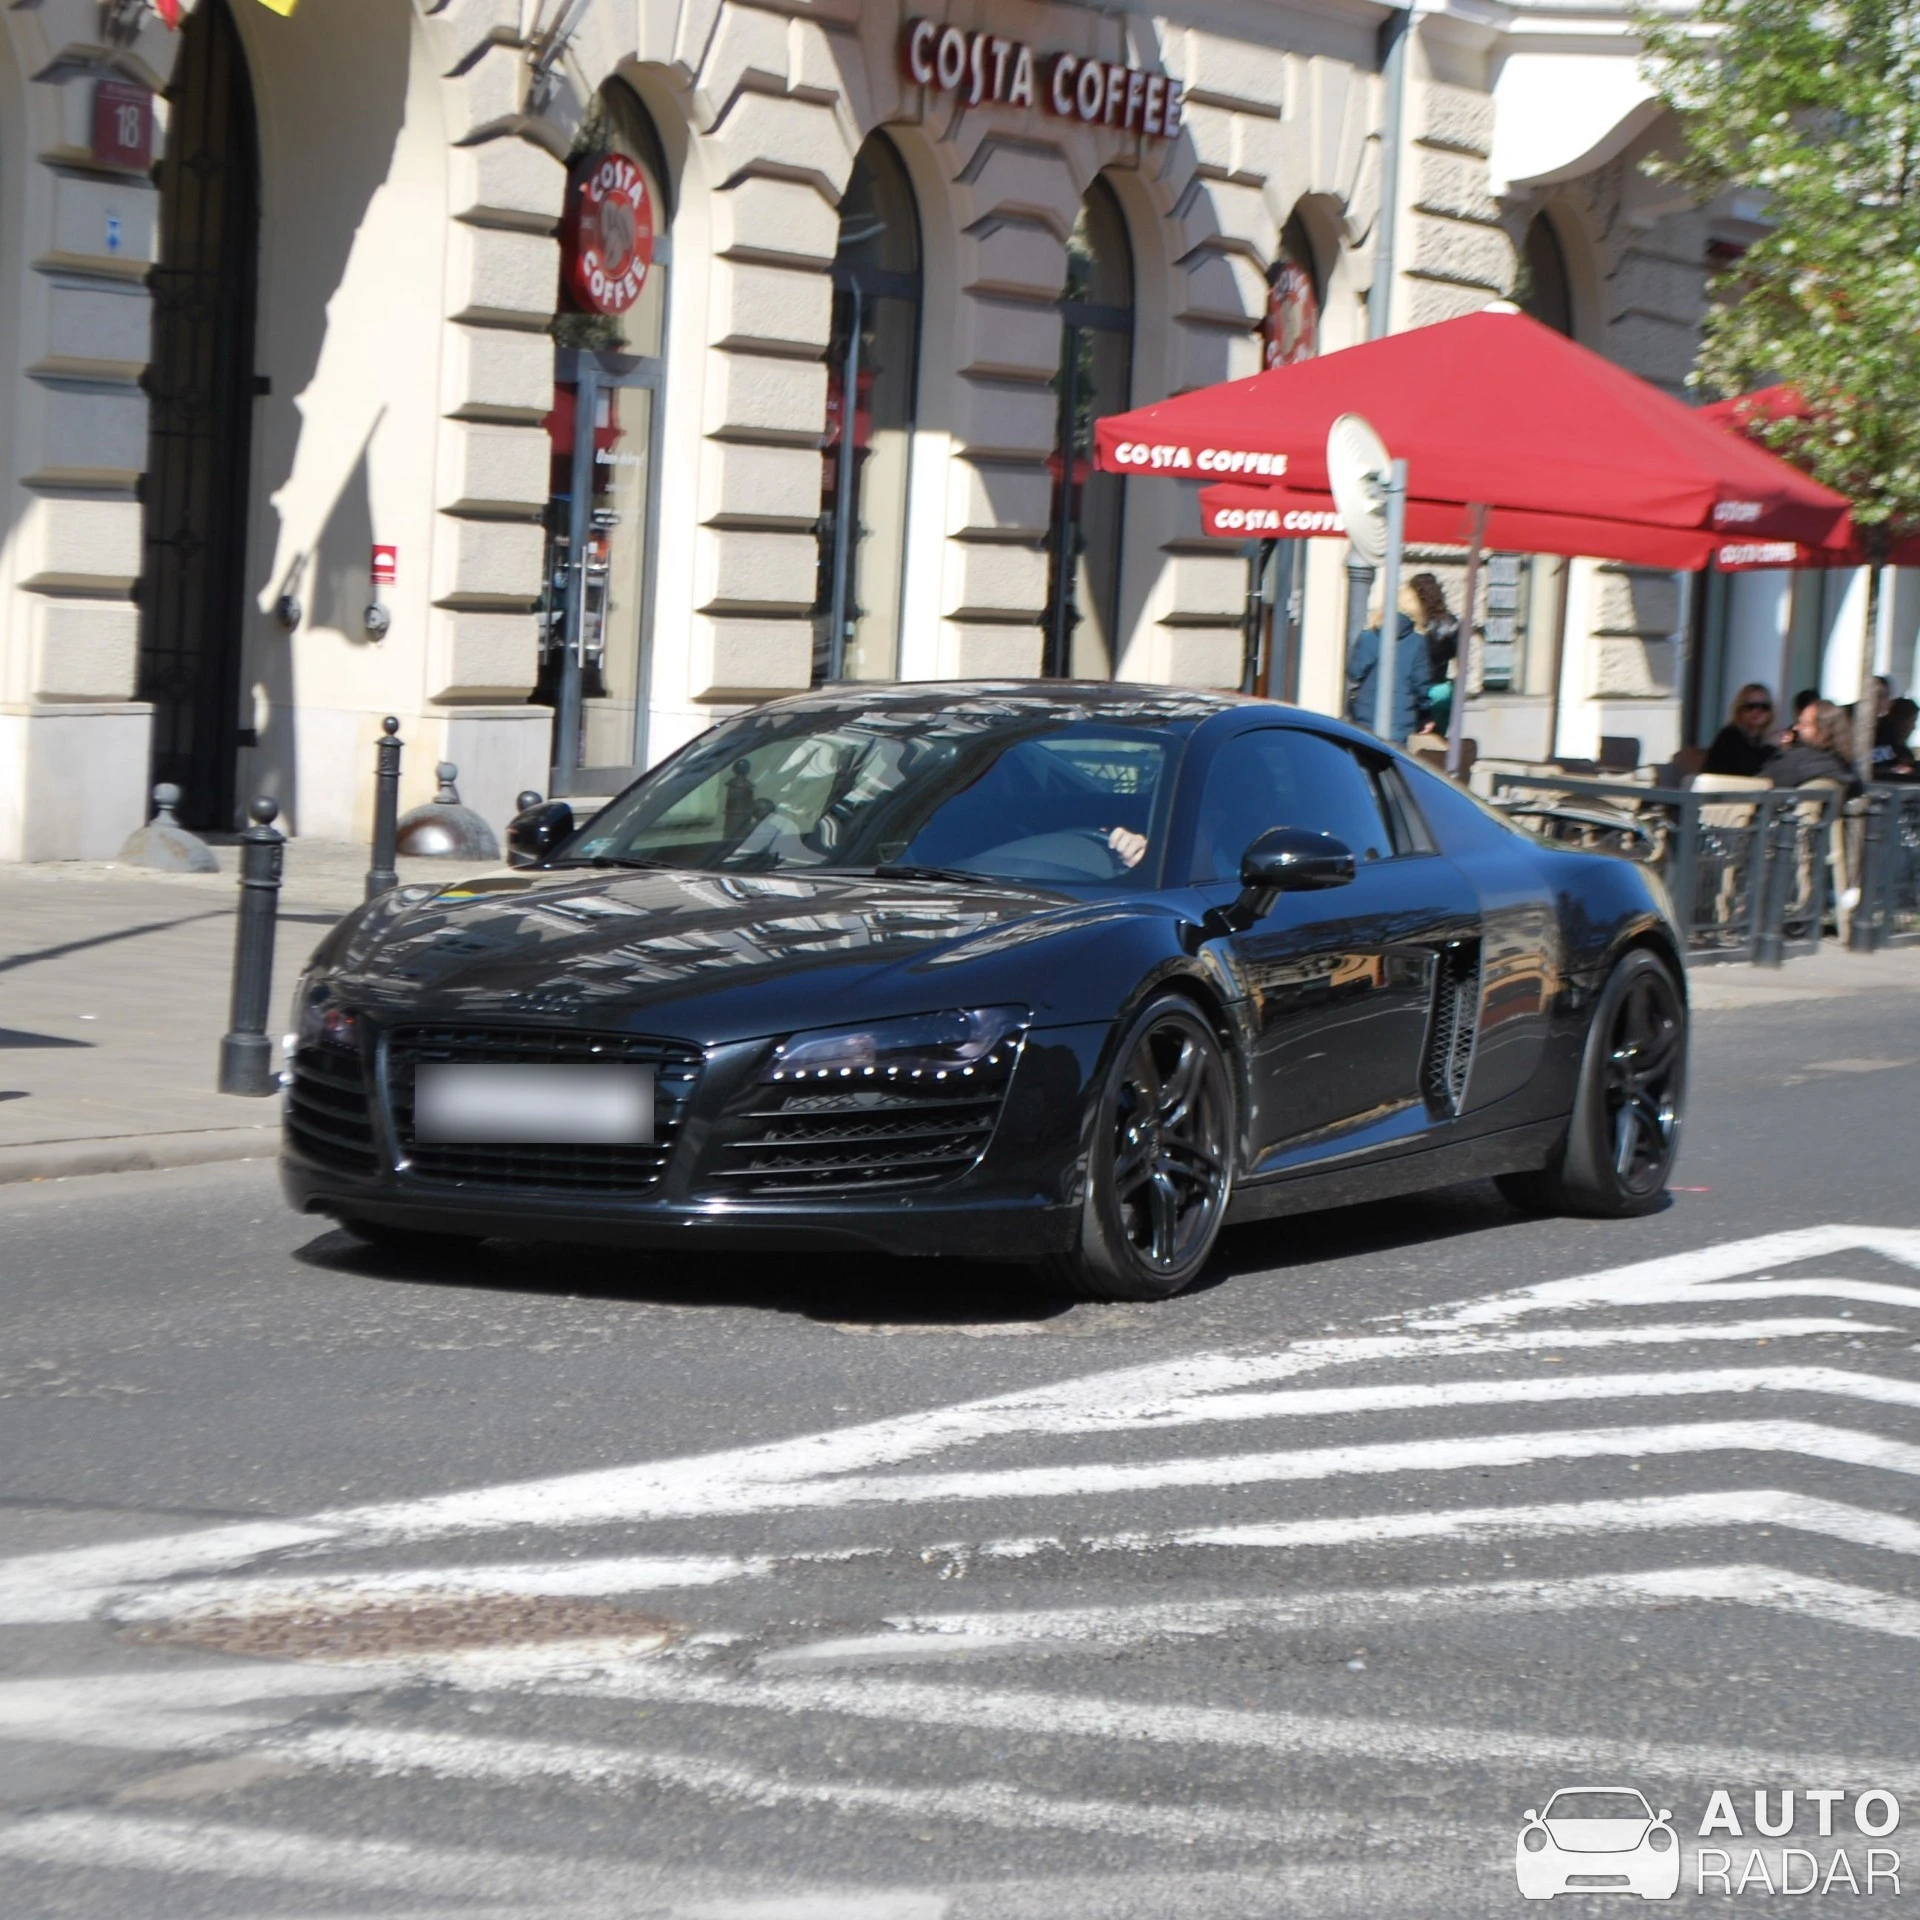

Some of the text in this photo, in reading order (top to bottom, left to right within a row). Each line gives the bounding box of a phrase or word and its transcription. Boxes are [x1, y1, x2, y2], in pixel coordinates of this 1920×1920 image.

[908, 19, 1183, 138] COSTA COFFEE
[114, 103, 140, 149] 18
[590, 159, 643, 209] COSTA
[583, 250, 646, 308] COFFEE
[1114, 441, 1288, 476] COSTA COFFEE
[1214, 508, 1346, 533] COSTA COFFE
